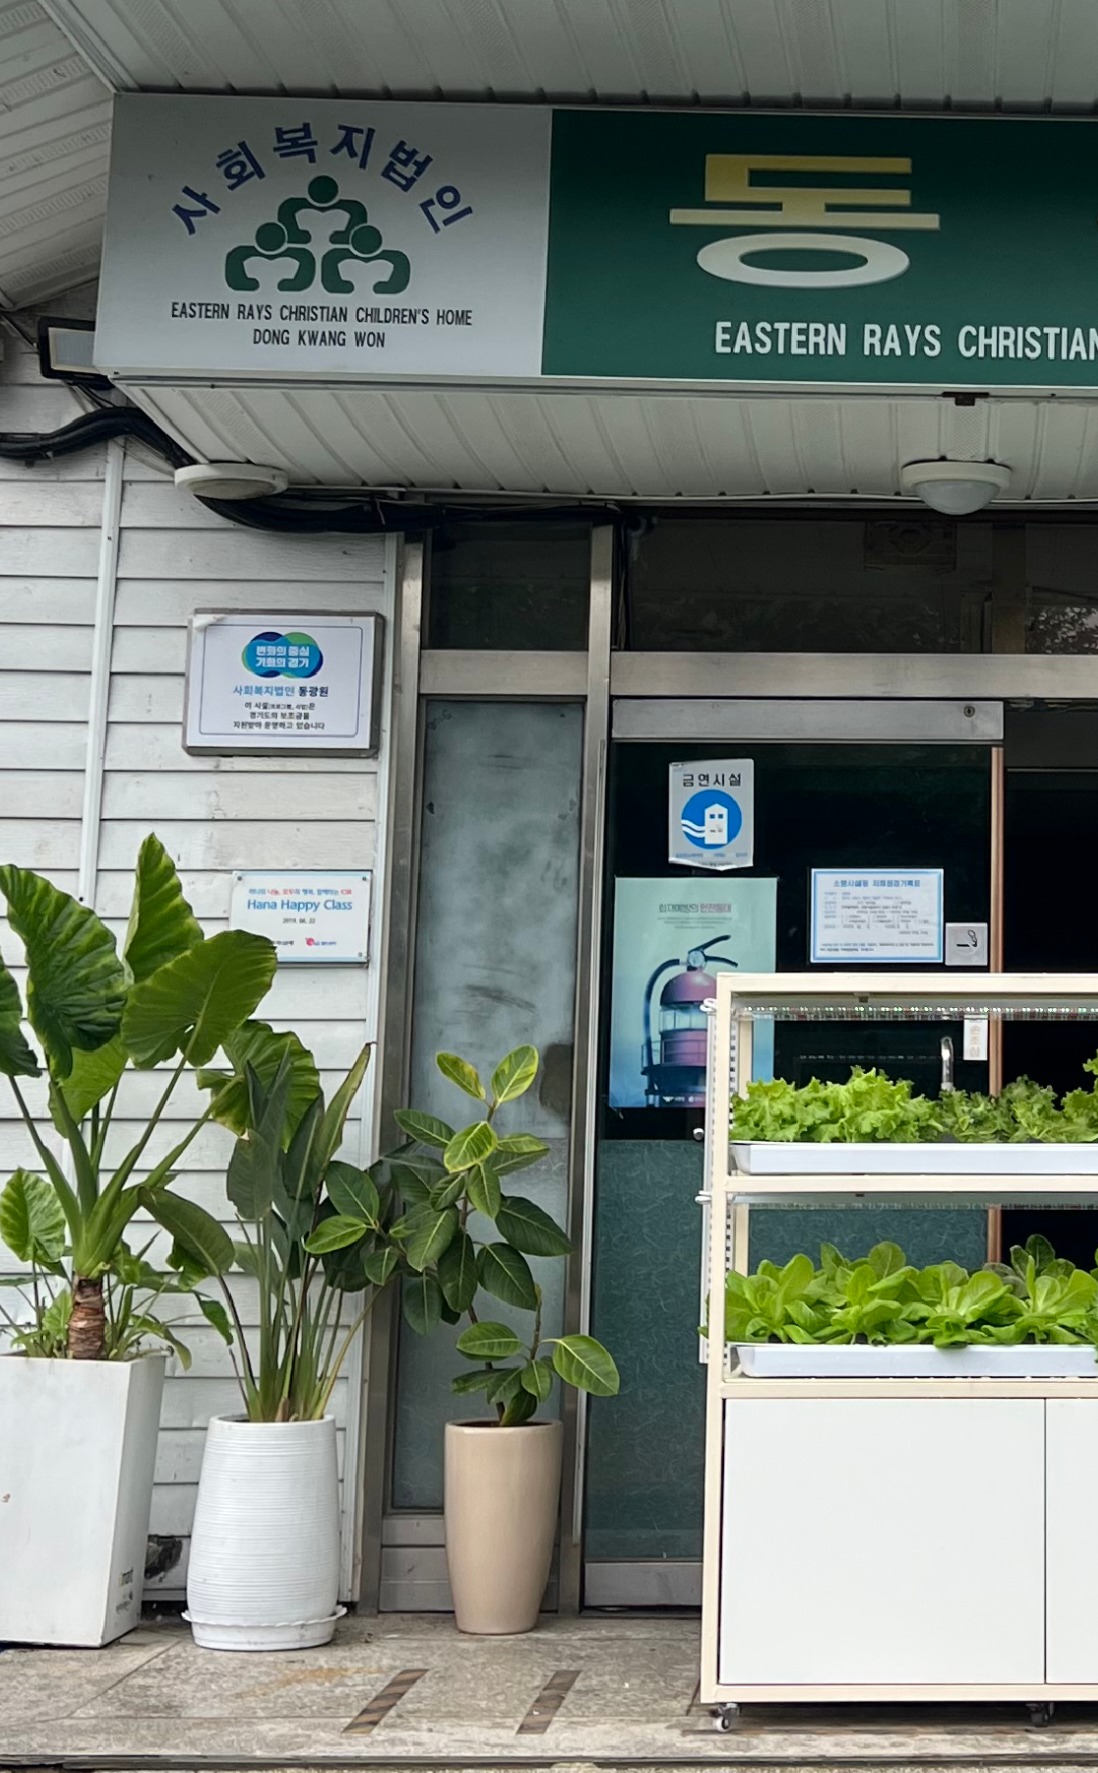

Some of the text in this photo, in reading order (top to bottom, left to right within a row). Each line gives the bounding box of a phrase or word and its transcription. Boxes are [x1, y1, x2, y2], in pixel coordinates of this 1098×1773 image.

[172, 121, 473, 235] 사회복지법인
[171, 302, 473, 326] EASTERN RAYS CHRISTIAN CHILDREN'S HOME
[253, 328, 386, 348] DONG KWANG WON
[714, 321, 847, 356] EASTERN
[863, 323, 941, 357] RAYS
[233, 685, 329, 697] 사회복지법인 동광원
[682, 773, 742, 788] 금연시설
[247, 899, 353, 912] Hana Happy Class
